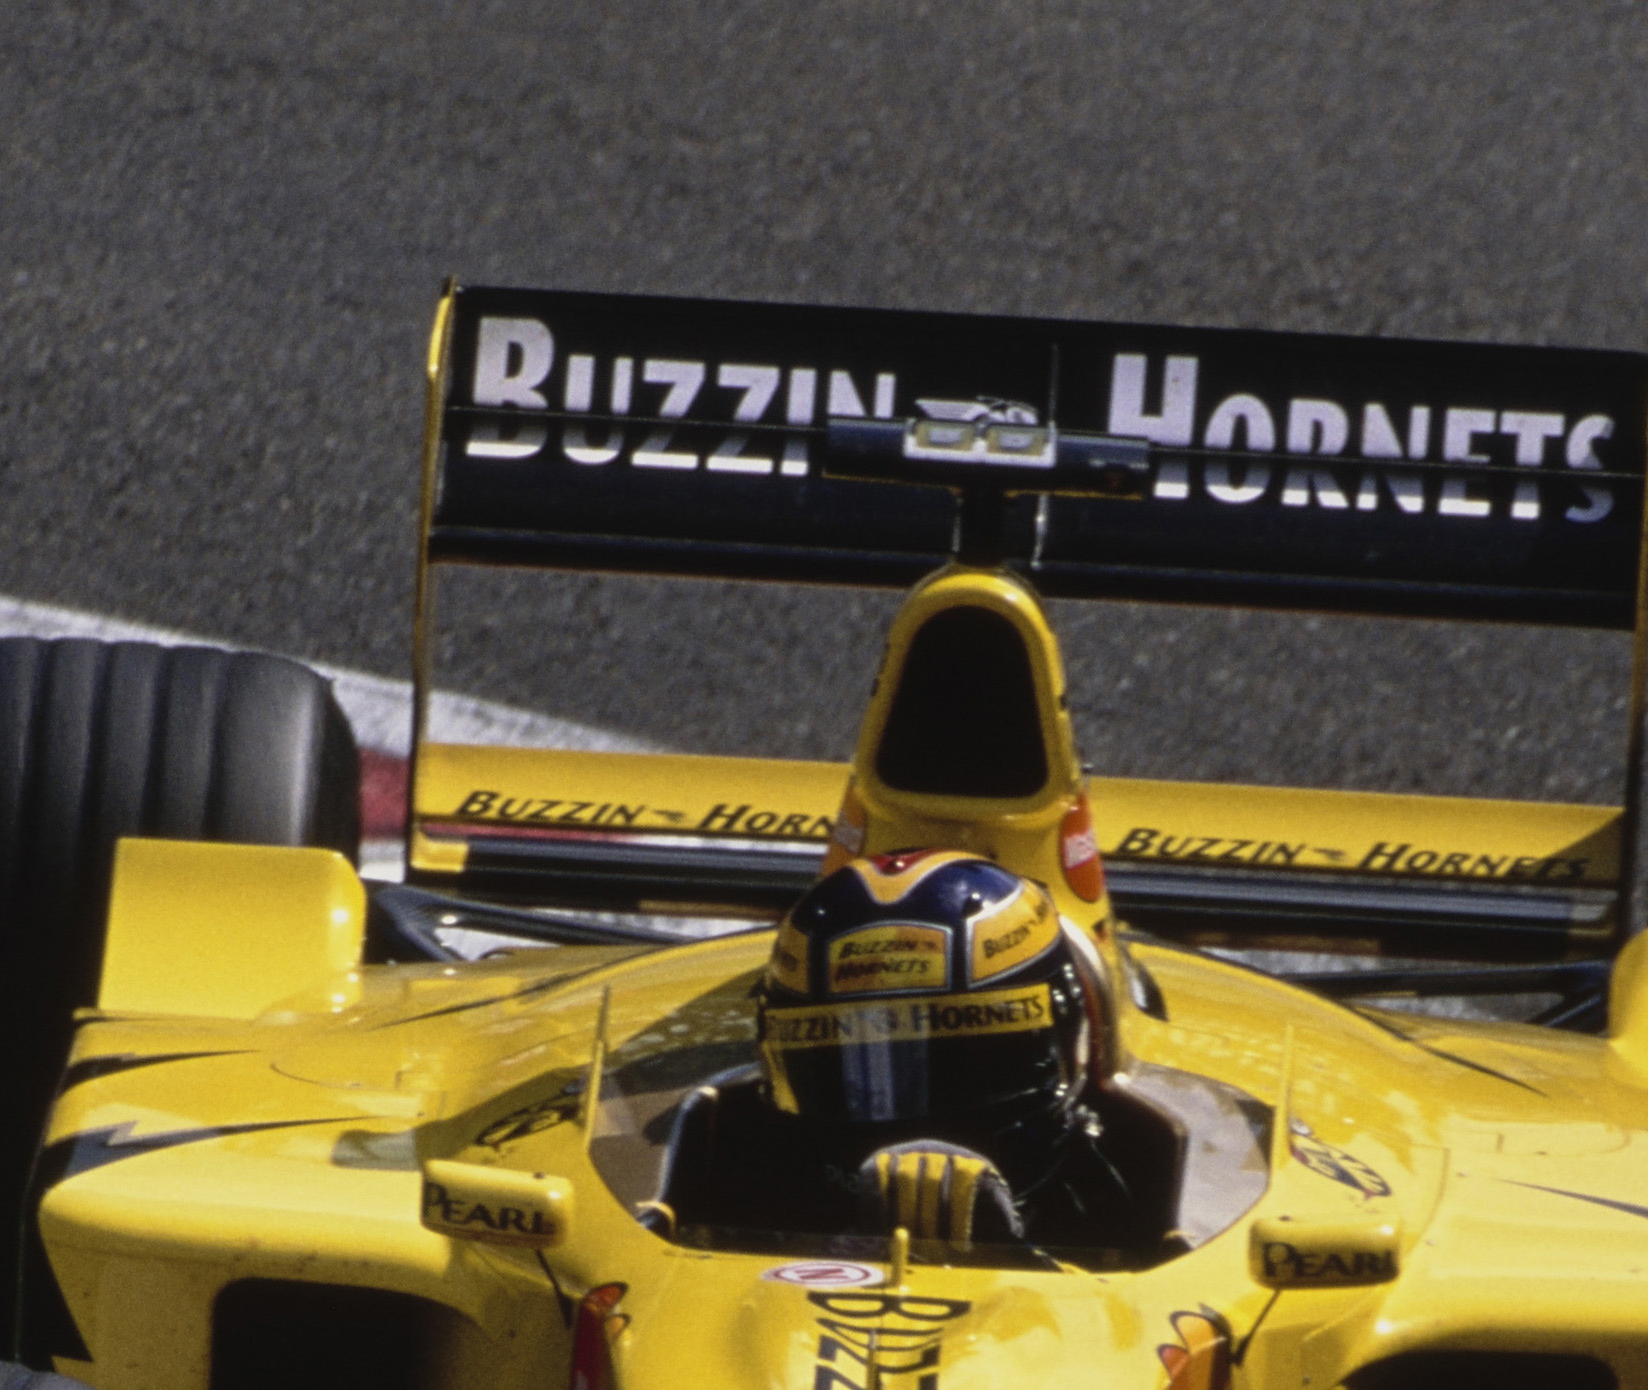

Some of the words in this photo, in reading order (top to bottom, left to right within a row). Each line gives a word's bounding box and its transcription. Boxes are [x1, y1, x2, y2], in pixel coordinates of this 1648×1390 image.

[1108, 353, 1615, 523] HORNETS
[455, 789, 646, 825] BUZZIN
[696, 803, 837, 836] HORN
[1114, 827, 1307, 865] BUZZIN
[1355, 840, 1591, 882] HORNETS
[909, 995, 1045, 1032] HORNETS
[424, 1181, 556, 1235] PEARL
